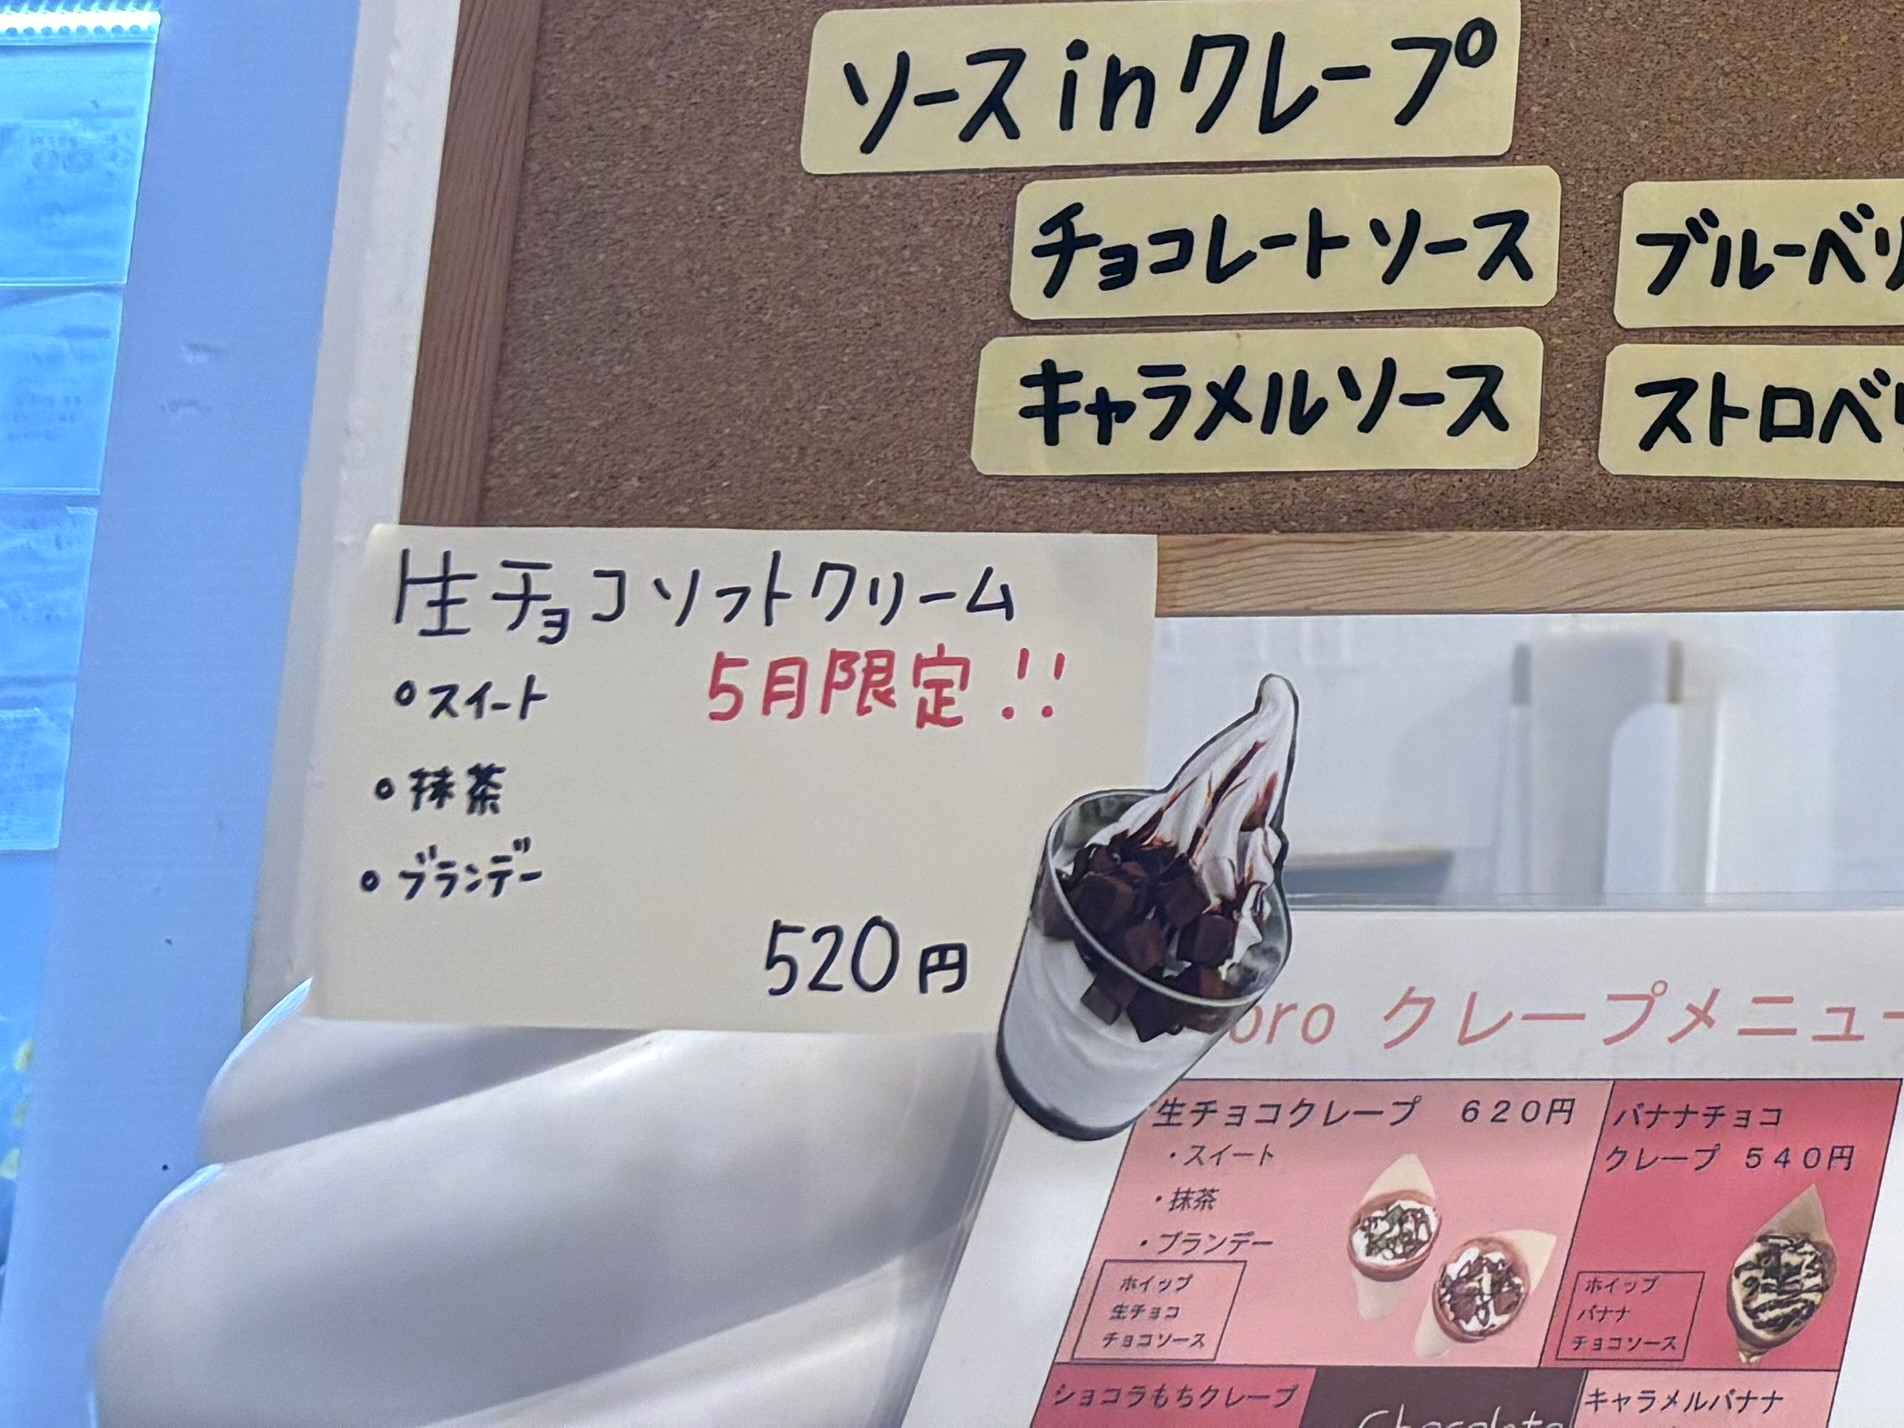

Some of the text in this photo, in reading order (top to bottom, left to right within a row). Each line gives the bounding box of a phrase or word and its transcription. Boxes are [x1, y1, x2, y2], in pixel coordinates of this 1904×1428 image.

[843, 16, 1498, 155] ソースinクレープ
[1030, 201, 1534, 299] チョコレートソース
[1018, 356, 1510, 447] キャラメルソース
[392, 546, 1017, 648] 生チョコソフトクリーム
[764, 913, 970, 998] 520円
[1228, 1002, 1336, 1046] oro
[1152, 1094, 1423, 1129] 生チョコクレープ
[1612, 1102, 1784, 1130] バナナチョコ
[1605, 1143, 1721, 1172] クレープ
[1120, 1273, 1195, 1294] ホイップ
[1585, 1275, 1661, 1295] ホイップ
[1109, 1303, 1180, 1322] 生チョコ
[1576, 1303, 1631, 1323] バナナ
[1102, 1331, 1206, 1349] チョコソース
[1571, 1334, 1678, 1354] チョコソース
[1053, 1384, 1301, 1409] ショコラもちクレープ
[1585, 1389, 1785, 1415] キャラメルバナナ
